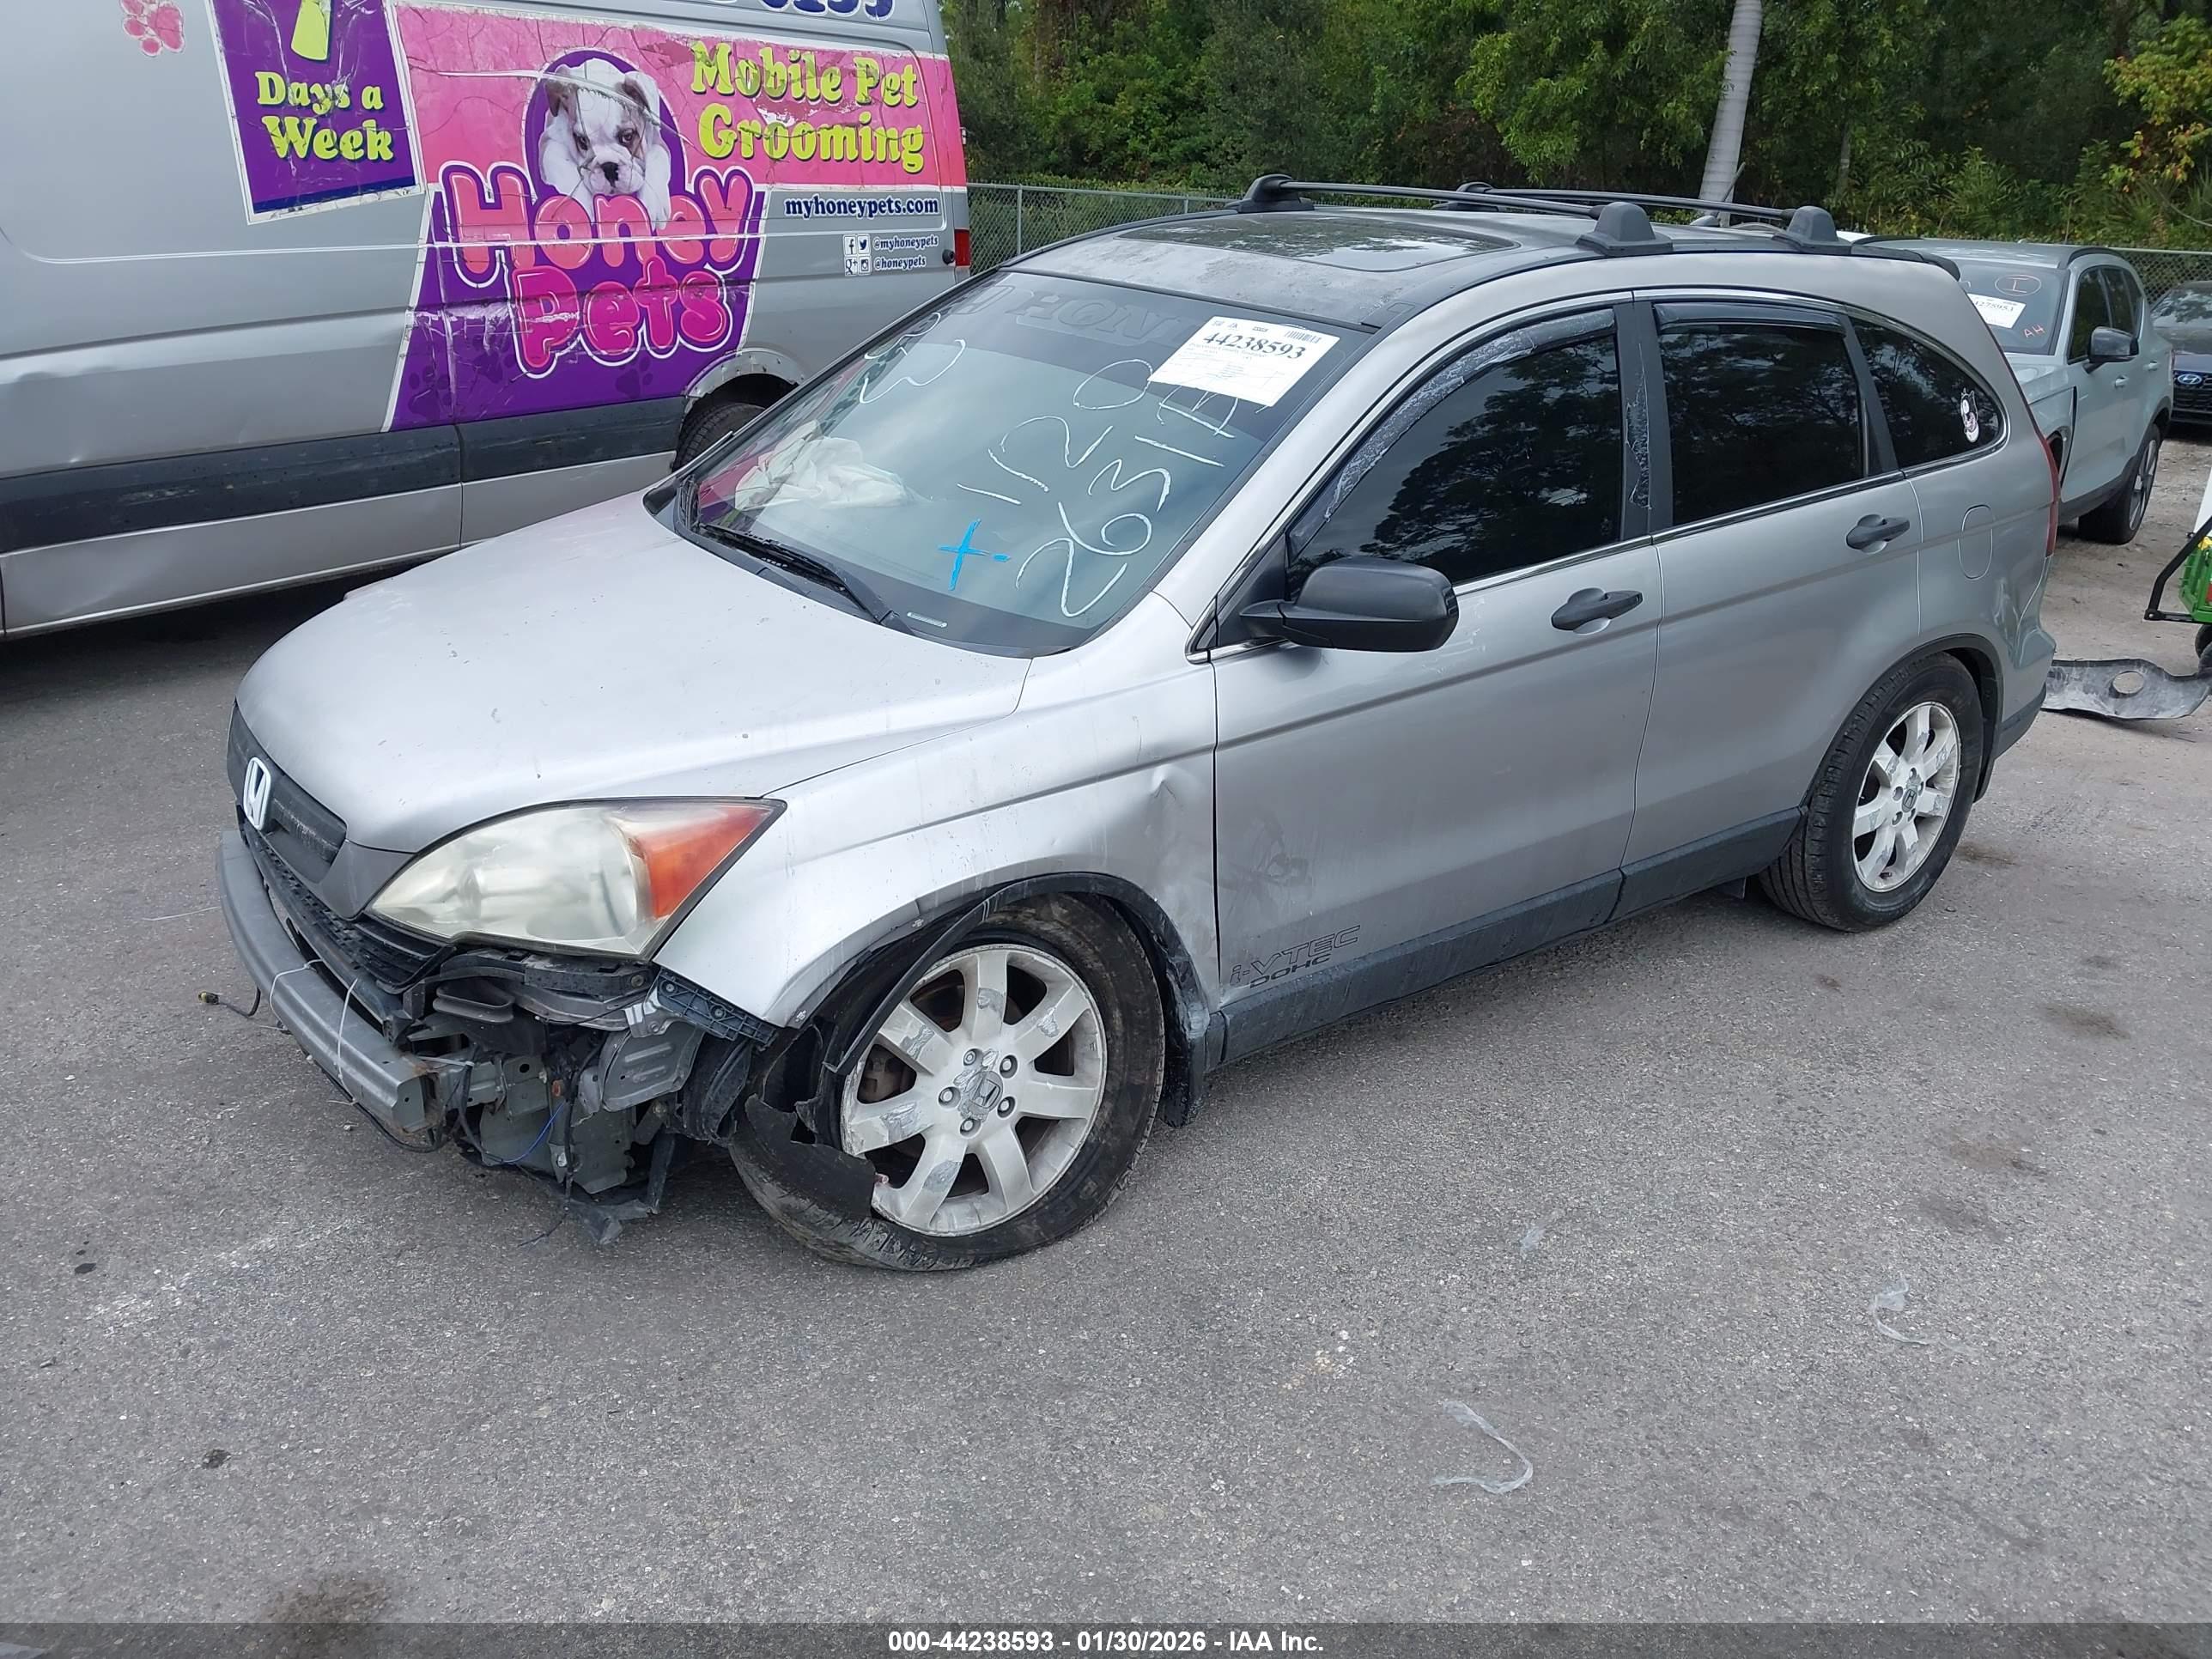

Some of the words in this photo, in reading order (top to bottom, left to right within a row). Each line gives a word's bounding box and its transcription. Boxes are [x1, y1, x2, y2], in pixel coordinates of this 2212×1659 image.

[254, 70, 350, 115] Days
[361, 85, 385, 110] a
[690, 40, 842, 106] Mobile
[853, 56, 918, 106] Pet
[260, 115, 394, 161] Week
[698, 102, 925, 173] Grooming
[447, 169, 751, 275] Honey
[783, 194, 939, 220] myhoneypets.com
[873, 234, 939, 251] @myhoneypets
[873, 255, 927, 271] @honeypets
[512, 254, 729, 369] Pets
[1004, 289, 1197, 345] HON
[1203, 331, 1307, 360] 44238593
[1249, 953, 1331, 988] DOHC
